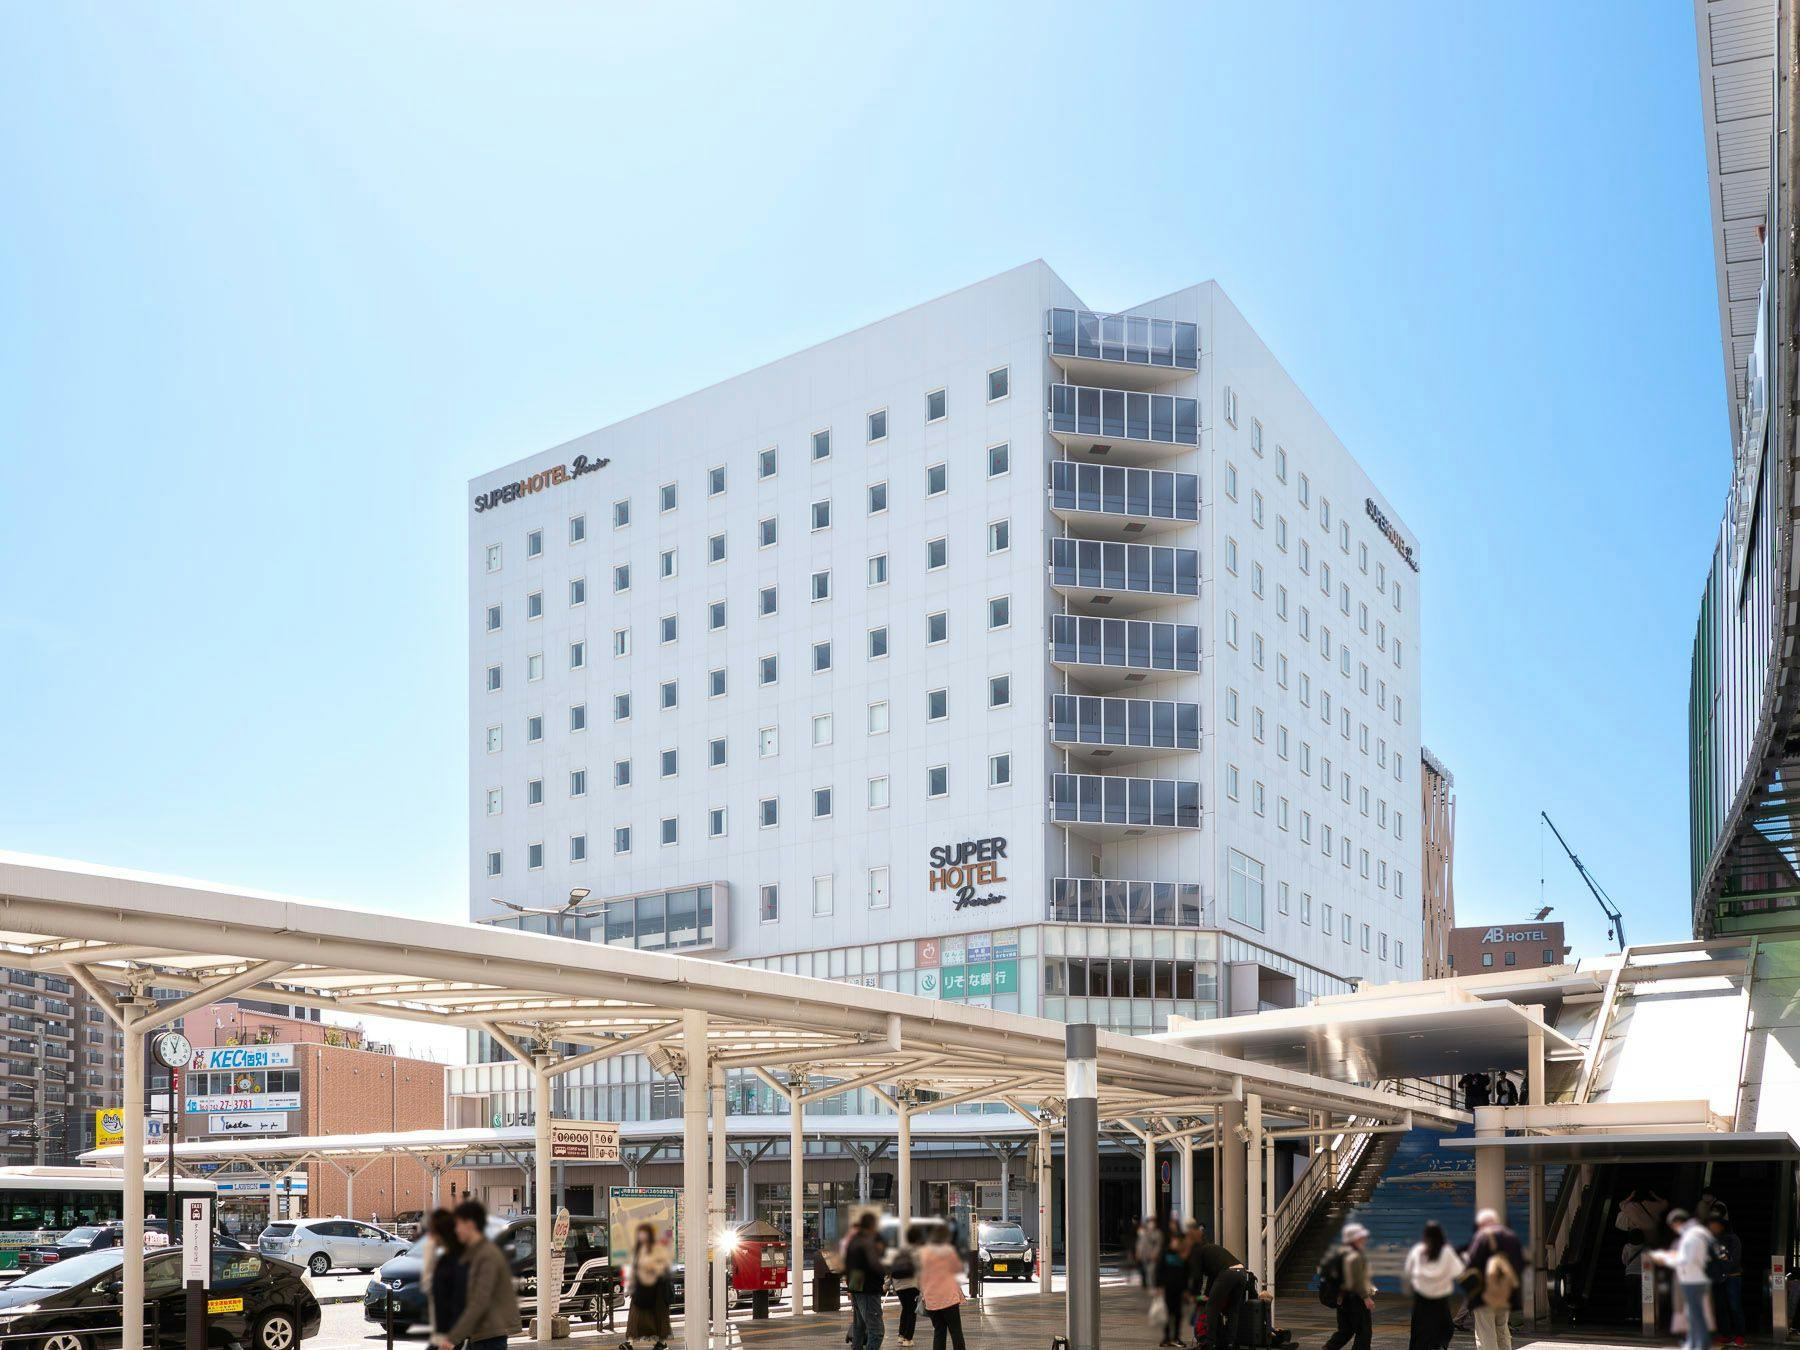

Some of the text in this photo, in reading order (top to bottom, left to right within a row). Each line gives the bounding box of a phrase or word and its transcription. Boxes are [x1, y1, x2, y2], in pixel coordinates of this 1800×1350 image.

[929, 836, 1007, 869] SUPER
[929, 860, 1007, 892] HOTEL
[952, 885, 1007, 912] Premier
[1481, 927, 1548, 944] AB HOTEL
[944, 970, 1007, 989] りそな銀行
[209, 1048, 269, 1069] KEC個別
[220, 1099, 252, 1110] 27-3781
